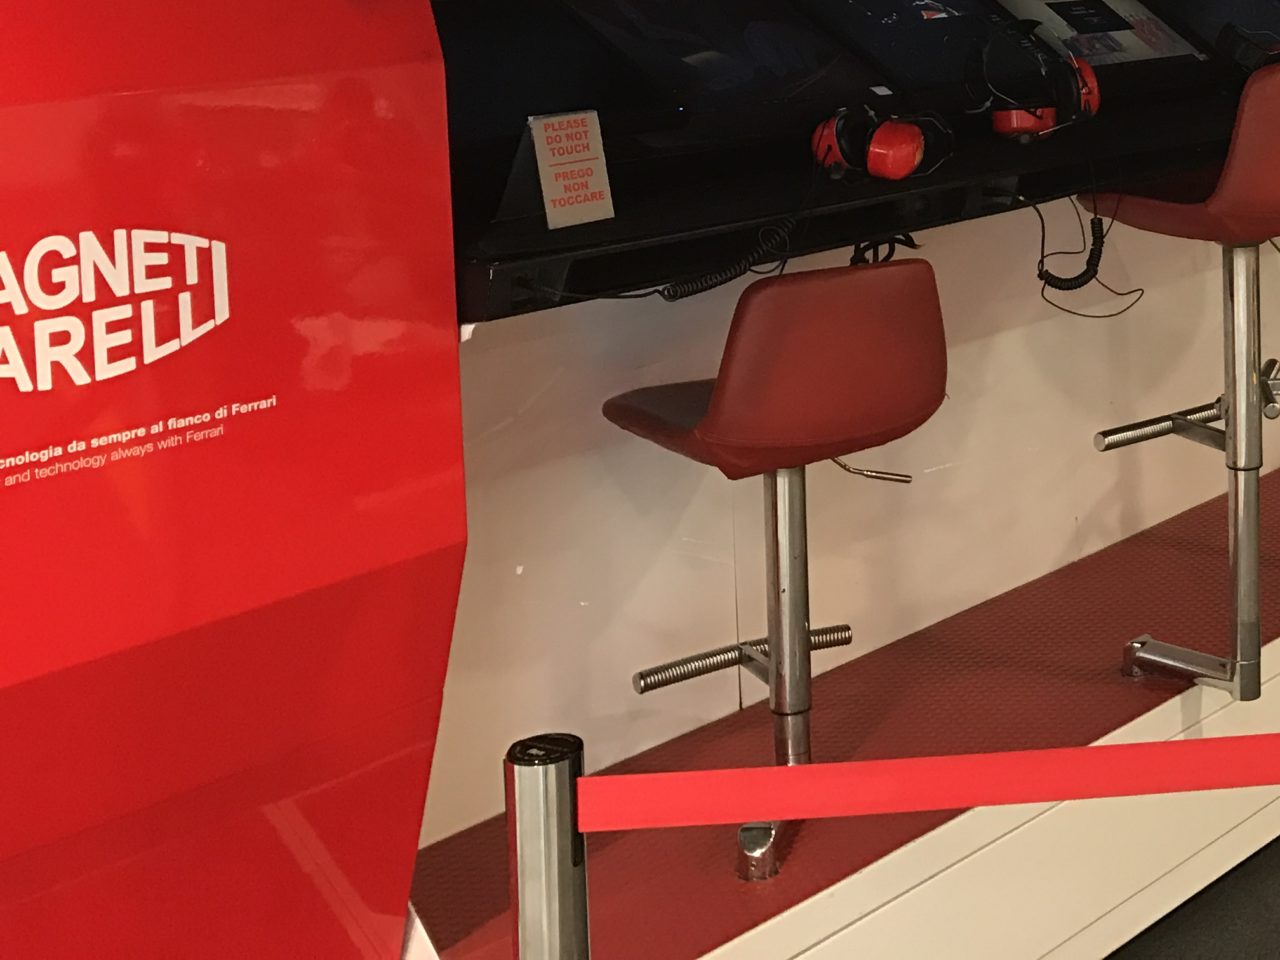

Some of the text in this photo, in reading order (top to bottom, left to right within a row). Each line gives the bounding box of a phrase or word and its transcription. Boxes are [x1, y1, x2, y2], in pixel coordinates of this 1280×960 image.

[543, 118, 588, 132] PLEASE
[545, 130, 589, 146] DO NOT
[549, 142, 590, 157] TOUCH
[554, 167, 594, 182] PREGO
[563, 181, 589, 193] NON
[551, 190, 605, 208] TOCCARE
[67, 440, 86, 453] da
[90, 427, 146, 448] sempre
[150, 421, 163, 434] al
[167, 413, 211, 430] fianco
[214, 405, 228, 419] di
[231, 395, 276, 416] Ferrari
[4, 424, 224, 486] and technology always with Ferrari
